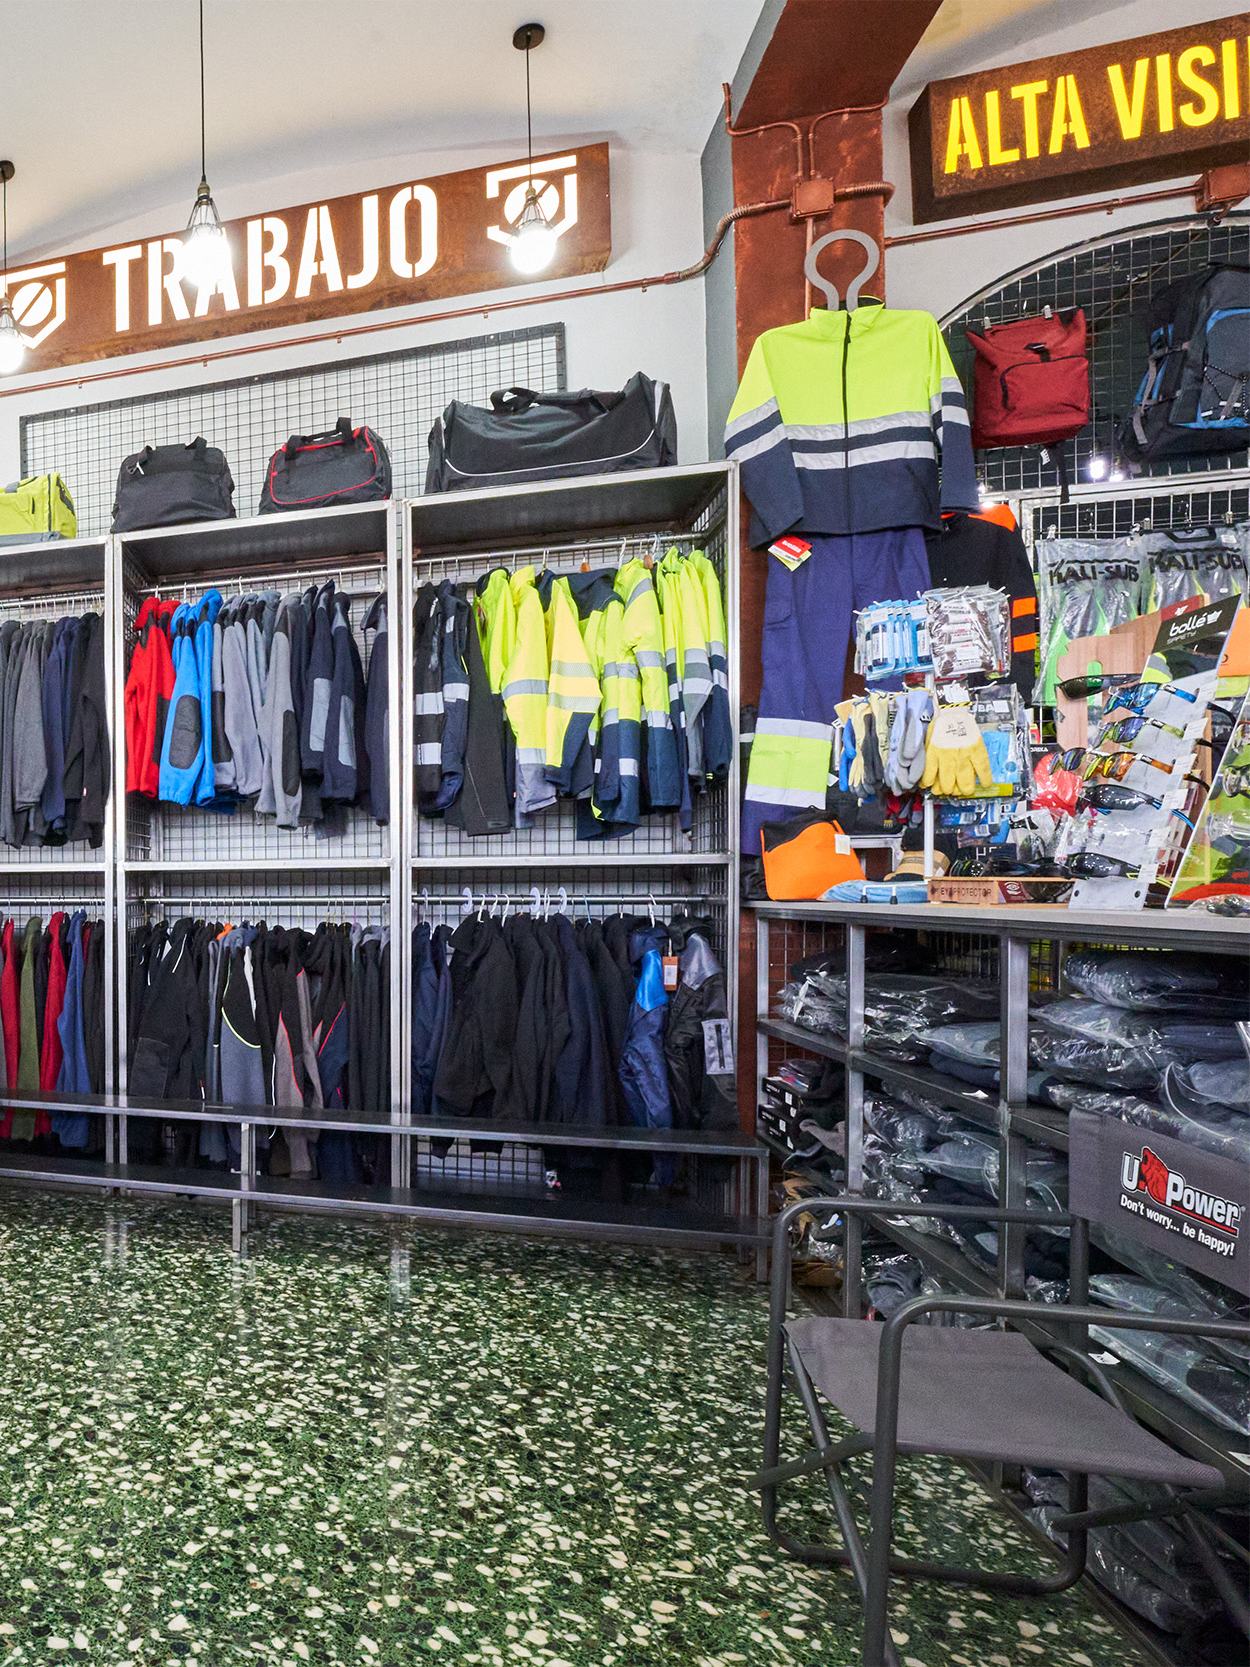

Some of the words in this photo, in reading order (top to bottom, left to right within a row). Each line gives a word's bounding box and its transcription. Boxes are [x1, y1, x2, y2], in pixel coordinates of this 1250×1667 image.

[944, 74, 1091, 174] ALTA
[1107, 36, 1250, 140] VISI
[102, 184, 439, 333] TRABAJO
[1049, 559, 1141, 585] KALI-SUB
[1169, 612, 1207, 637] bollé
[1120, 1193, 1145, 1216] Don't
[1146, 1208, 1180, 1232] worry...
[1182, 1221, 1196, 1239] be
[1198, 1229, 1236, 1256] happy!
[1165, 1171, 1240, 1228] Power
